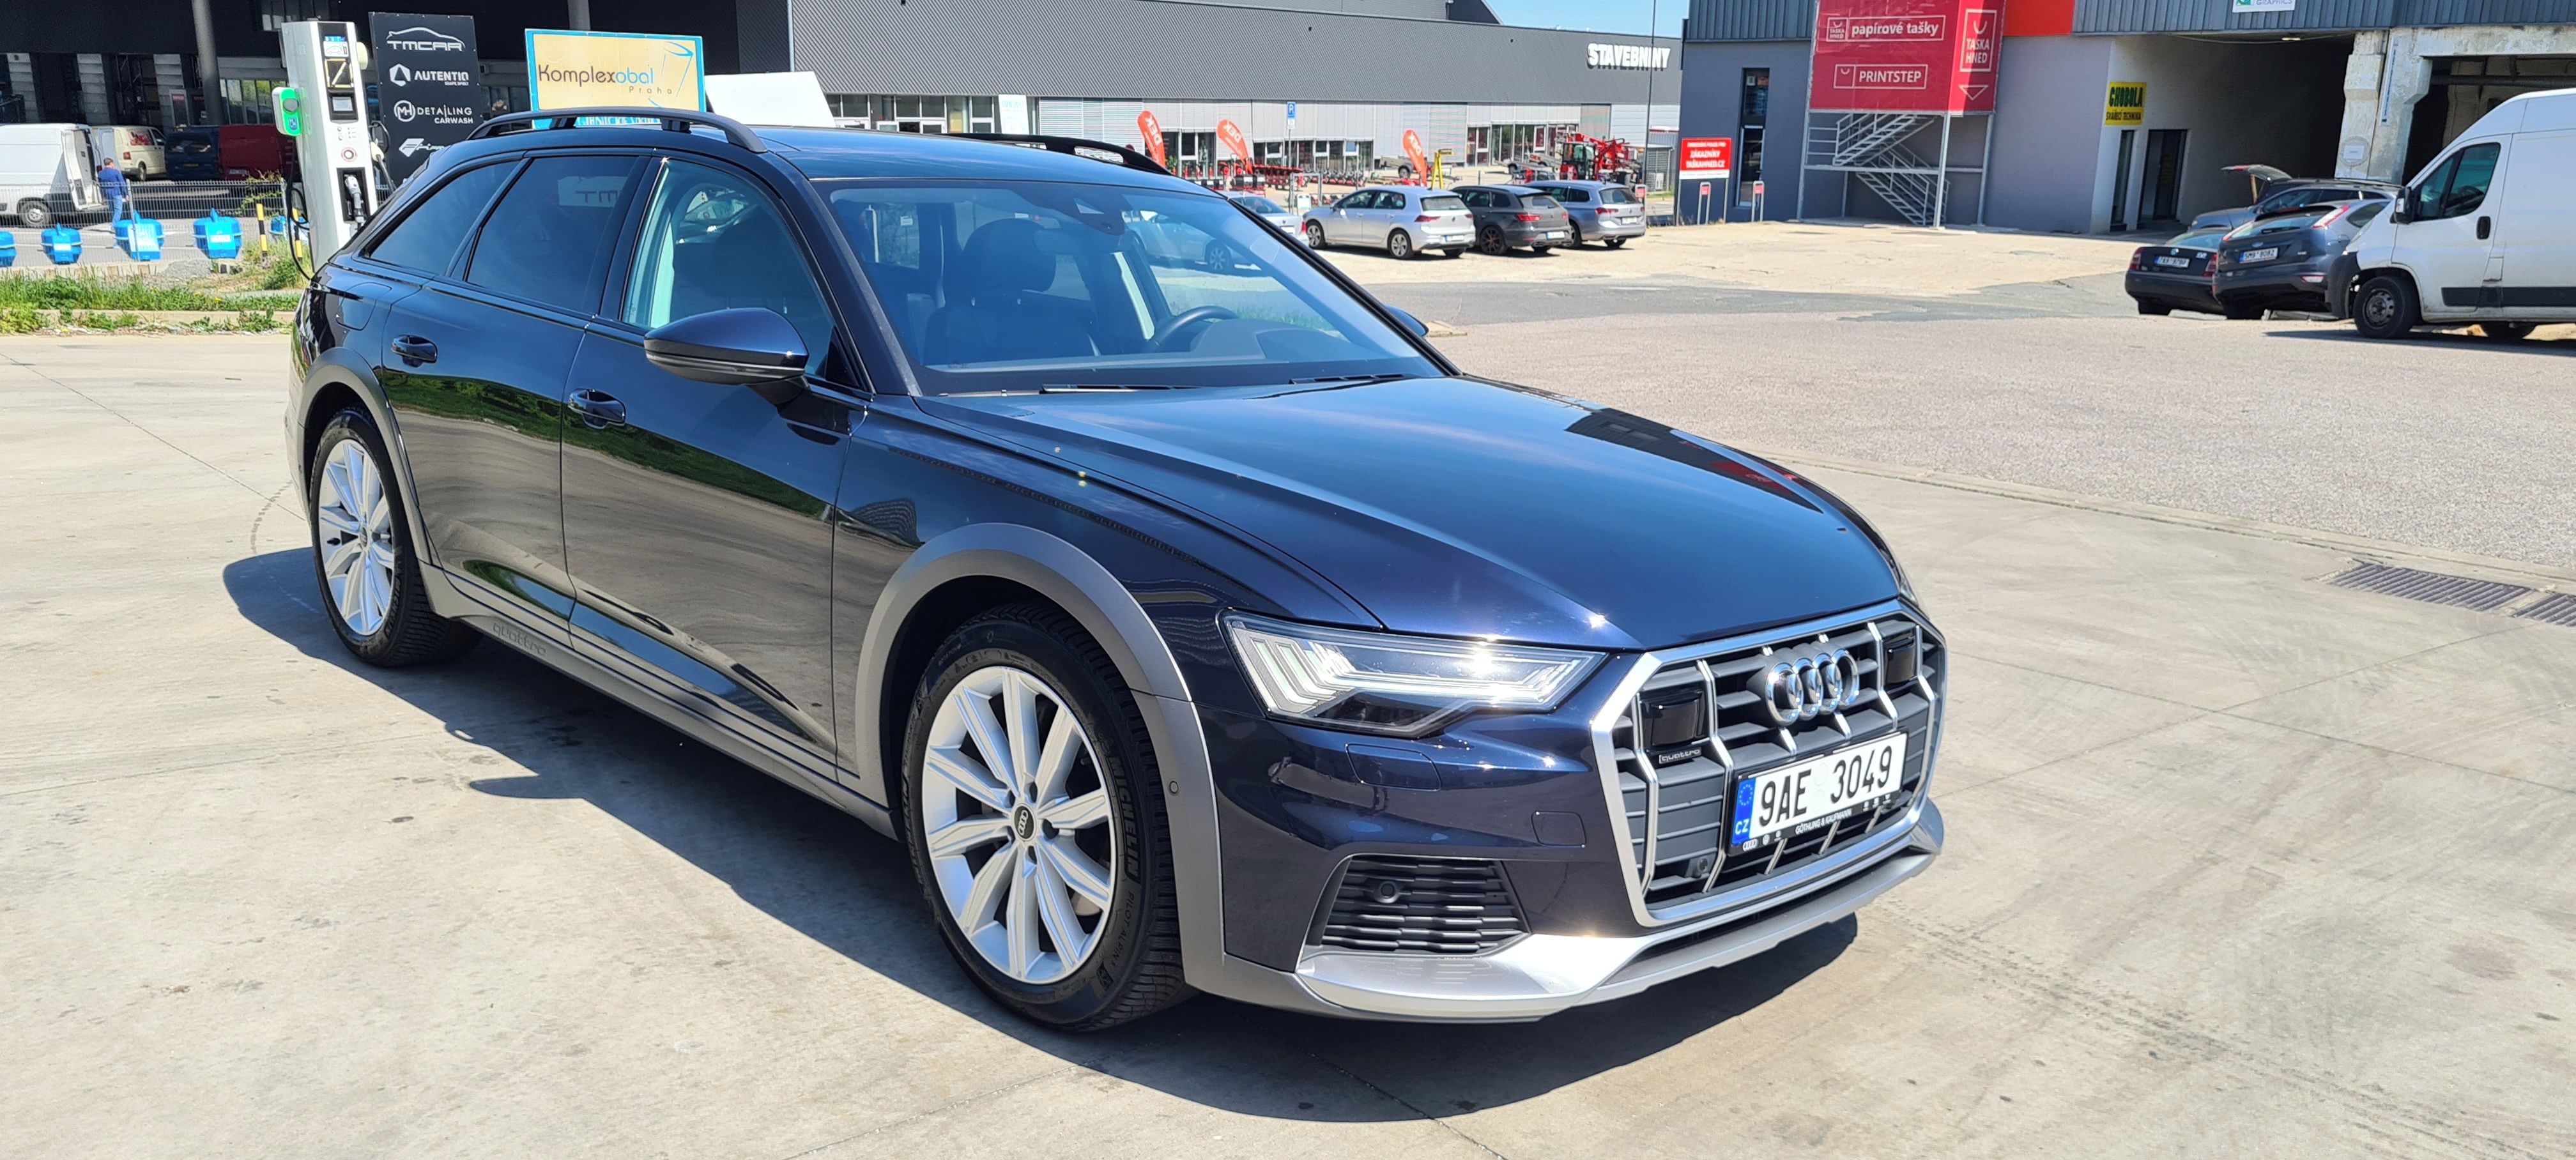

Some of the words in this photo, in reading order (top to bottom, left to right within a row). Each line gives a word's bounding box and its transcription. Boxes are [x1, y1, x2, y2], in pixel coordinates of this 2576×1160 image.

[1851, 22, 1903, 38] papírové
[1906, 20, 1939, 37] tašky
[387, 40, 463, 52] TMCAR
[1587, 43, 1671, 69] STAVEBNINY
[1965, 52, 1988, 64] HNED
[539, 64, 654, 87] Komplexobal
[1859, 70, 1922, 83] PRINTSTEP
[629, 86, 673, 95] Praha
[1661, 748, 1701, 762] quattro
[1758, 768, 1812, 827] 9AE
[1830, 745, 1892, 804] 3049
[1108, 756, 1141, 876] MICHELIN
[1735, 818, 1750, 836] CZ
